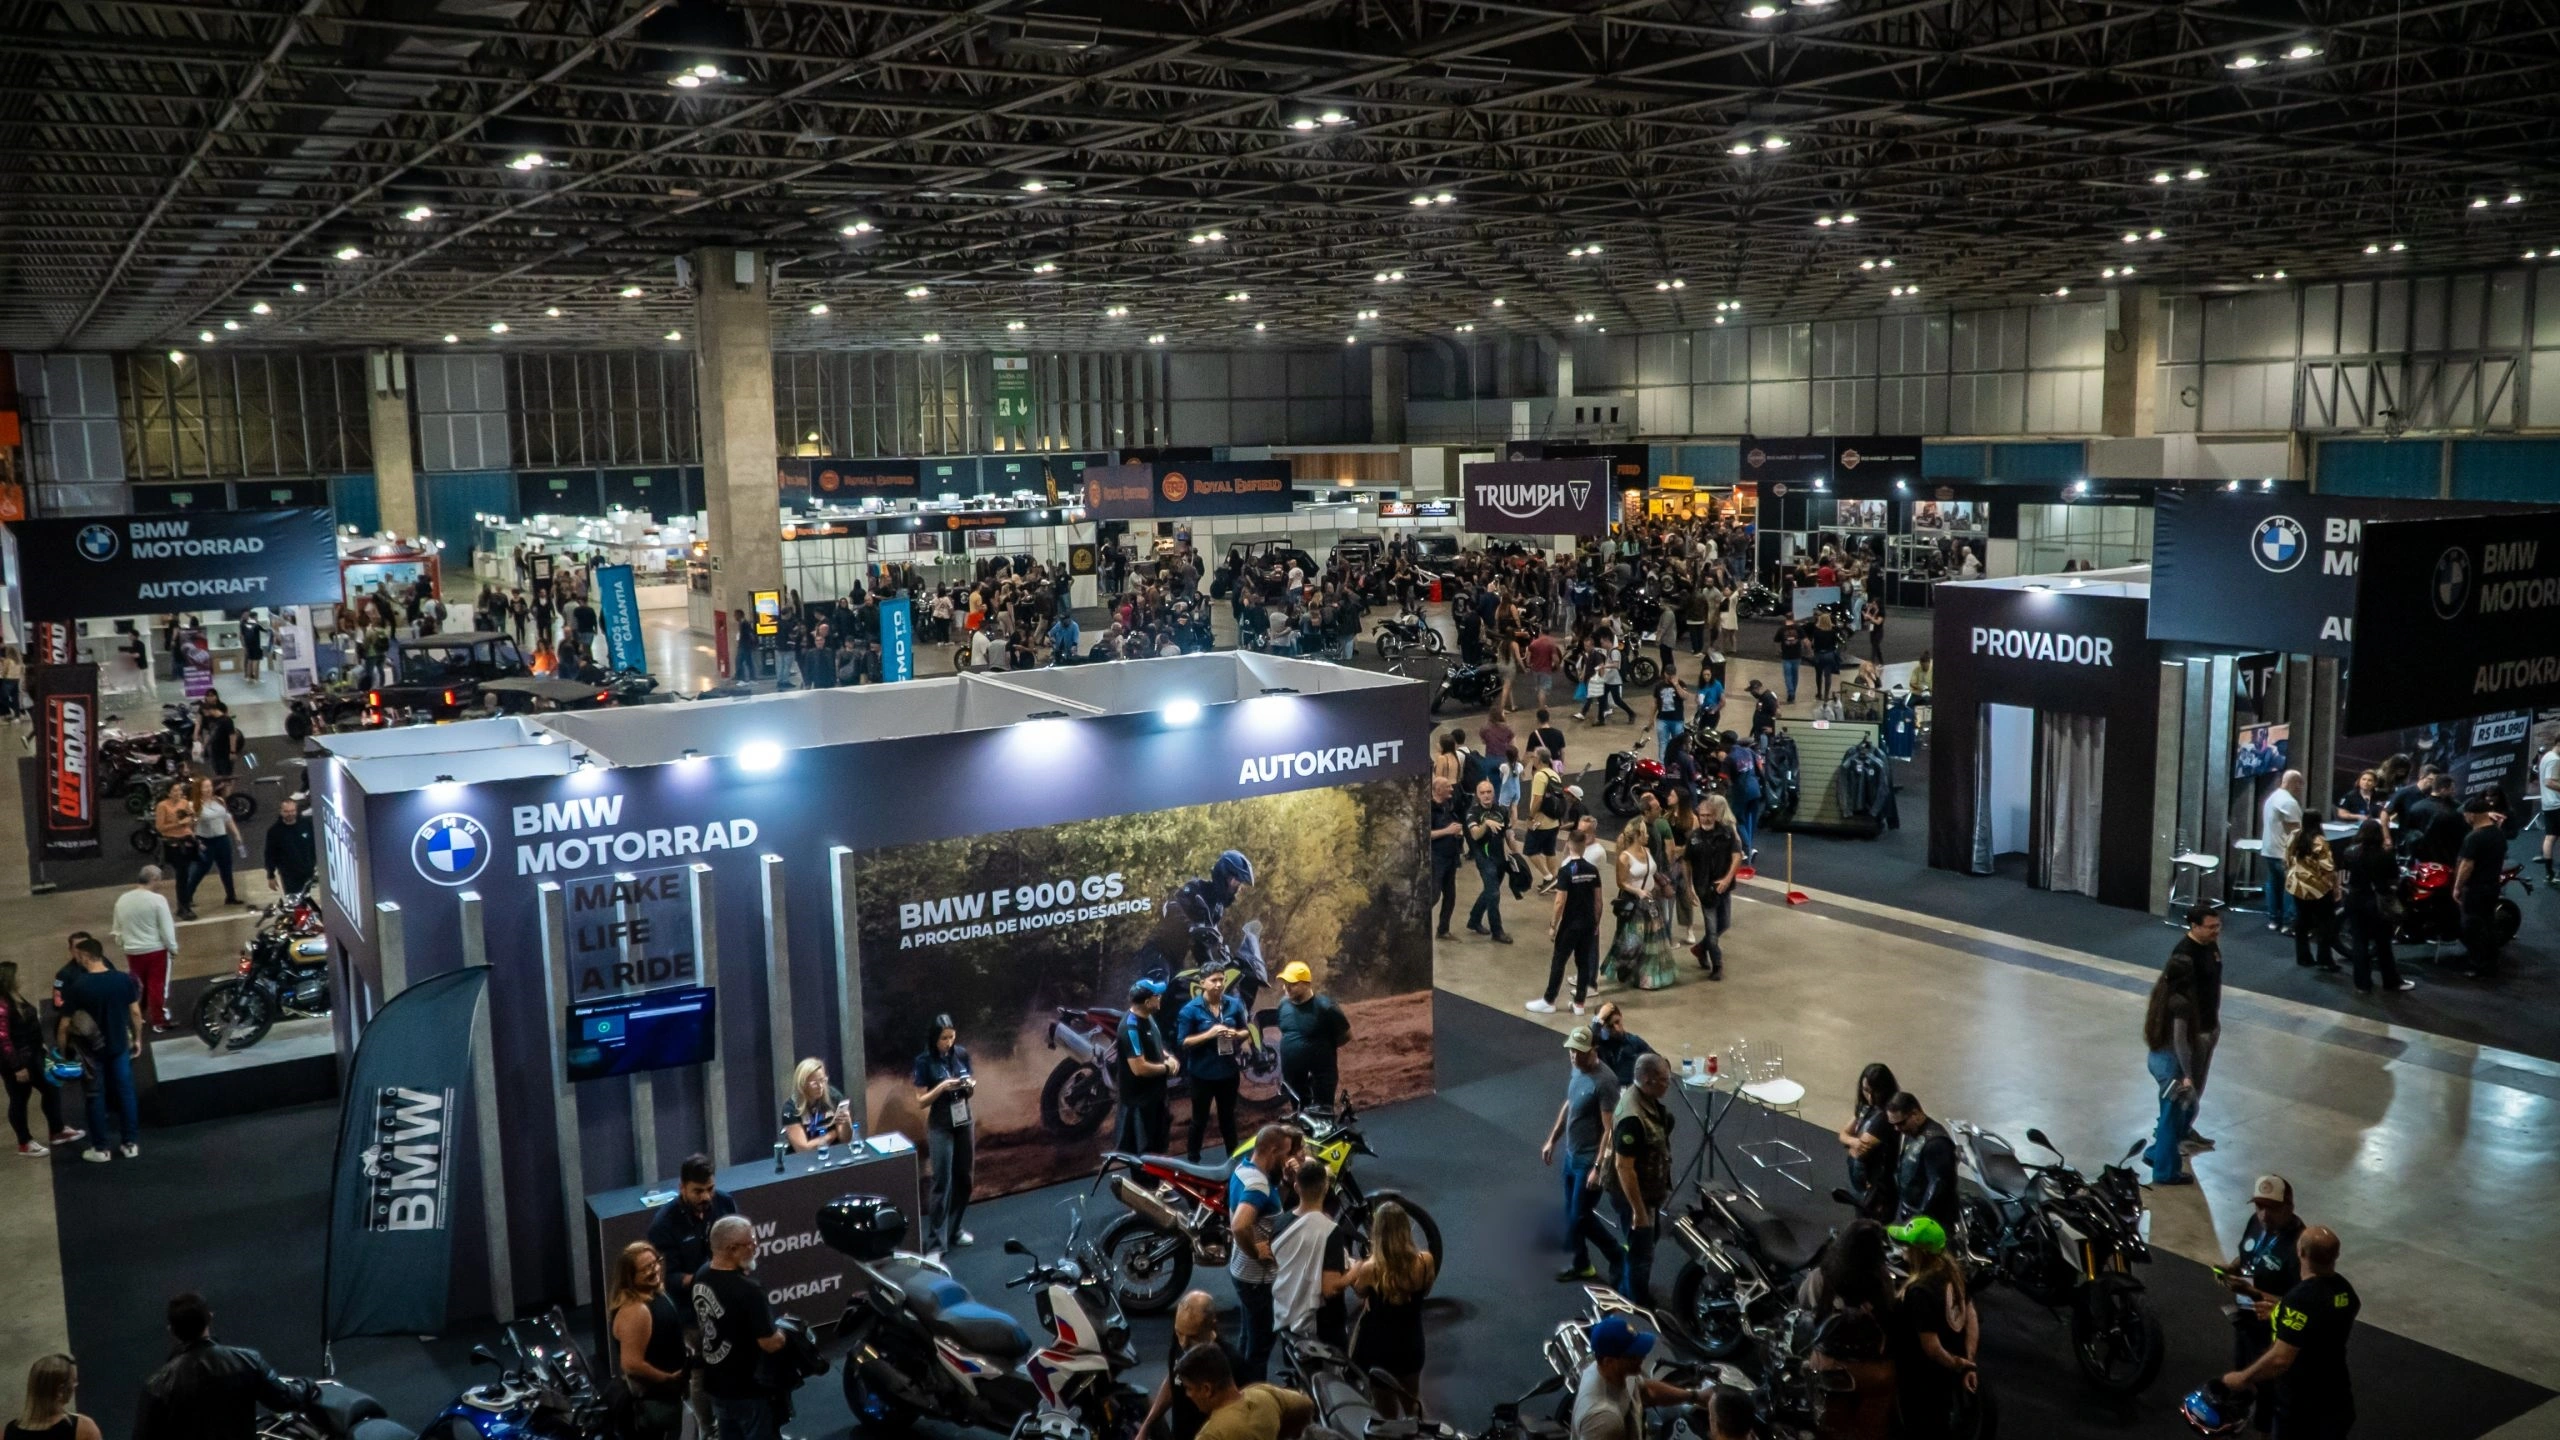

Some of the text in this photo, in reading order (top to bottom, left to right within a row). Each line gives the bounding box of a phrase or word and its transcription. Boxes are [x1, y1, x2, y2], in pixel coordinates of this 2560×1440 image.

[1193, 478, 1283, 494] ROYAL ENFIELD
[1475, 484, 1565, 513] TRIUMPH
[129, 521, 189, 539] BMW
[132, 538, 264, 559] MOTORRAD
[2483, 541, 2539, 575] BMW
[138, 576, 268, 599] AUTOKRAFT
[2480, 577, 2560, 614] MOTOR
[614, 581, 632, 641] GARANTIA
[612, 626, 626, 660] ANOS
[1971, 627, 2113, 667] PROVADOR
[2478, 726, 2491, 741] R$
[1238, 740, 1403, 784] AUTOKRAFT
[421, 817, 479, 841] BMW
[512, 795, 624, 836] BMW
[517, 818, 759, 875] MOTORRAD
[574, 873, 680, 912] MAKE
[900, 872, 1124, 929] BMW F 900 GS
[578, 918, 651, 953] LIFE
[900, 898, 1151, 950] A PROCURA DE NOVOS DESAFIOS
[580, 953, 694, 993] A RIDE
[388, 1088, 442, 1231] BMW
